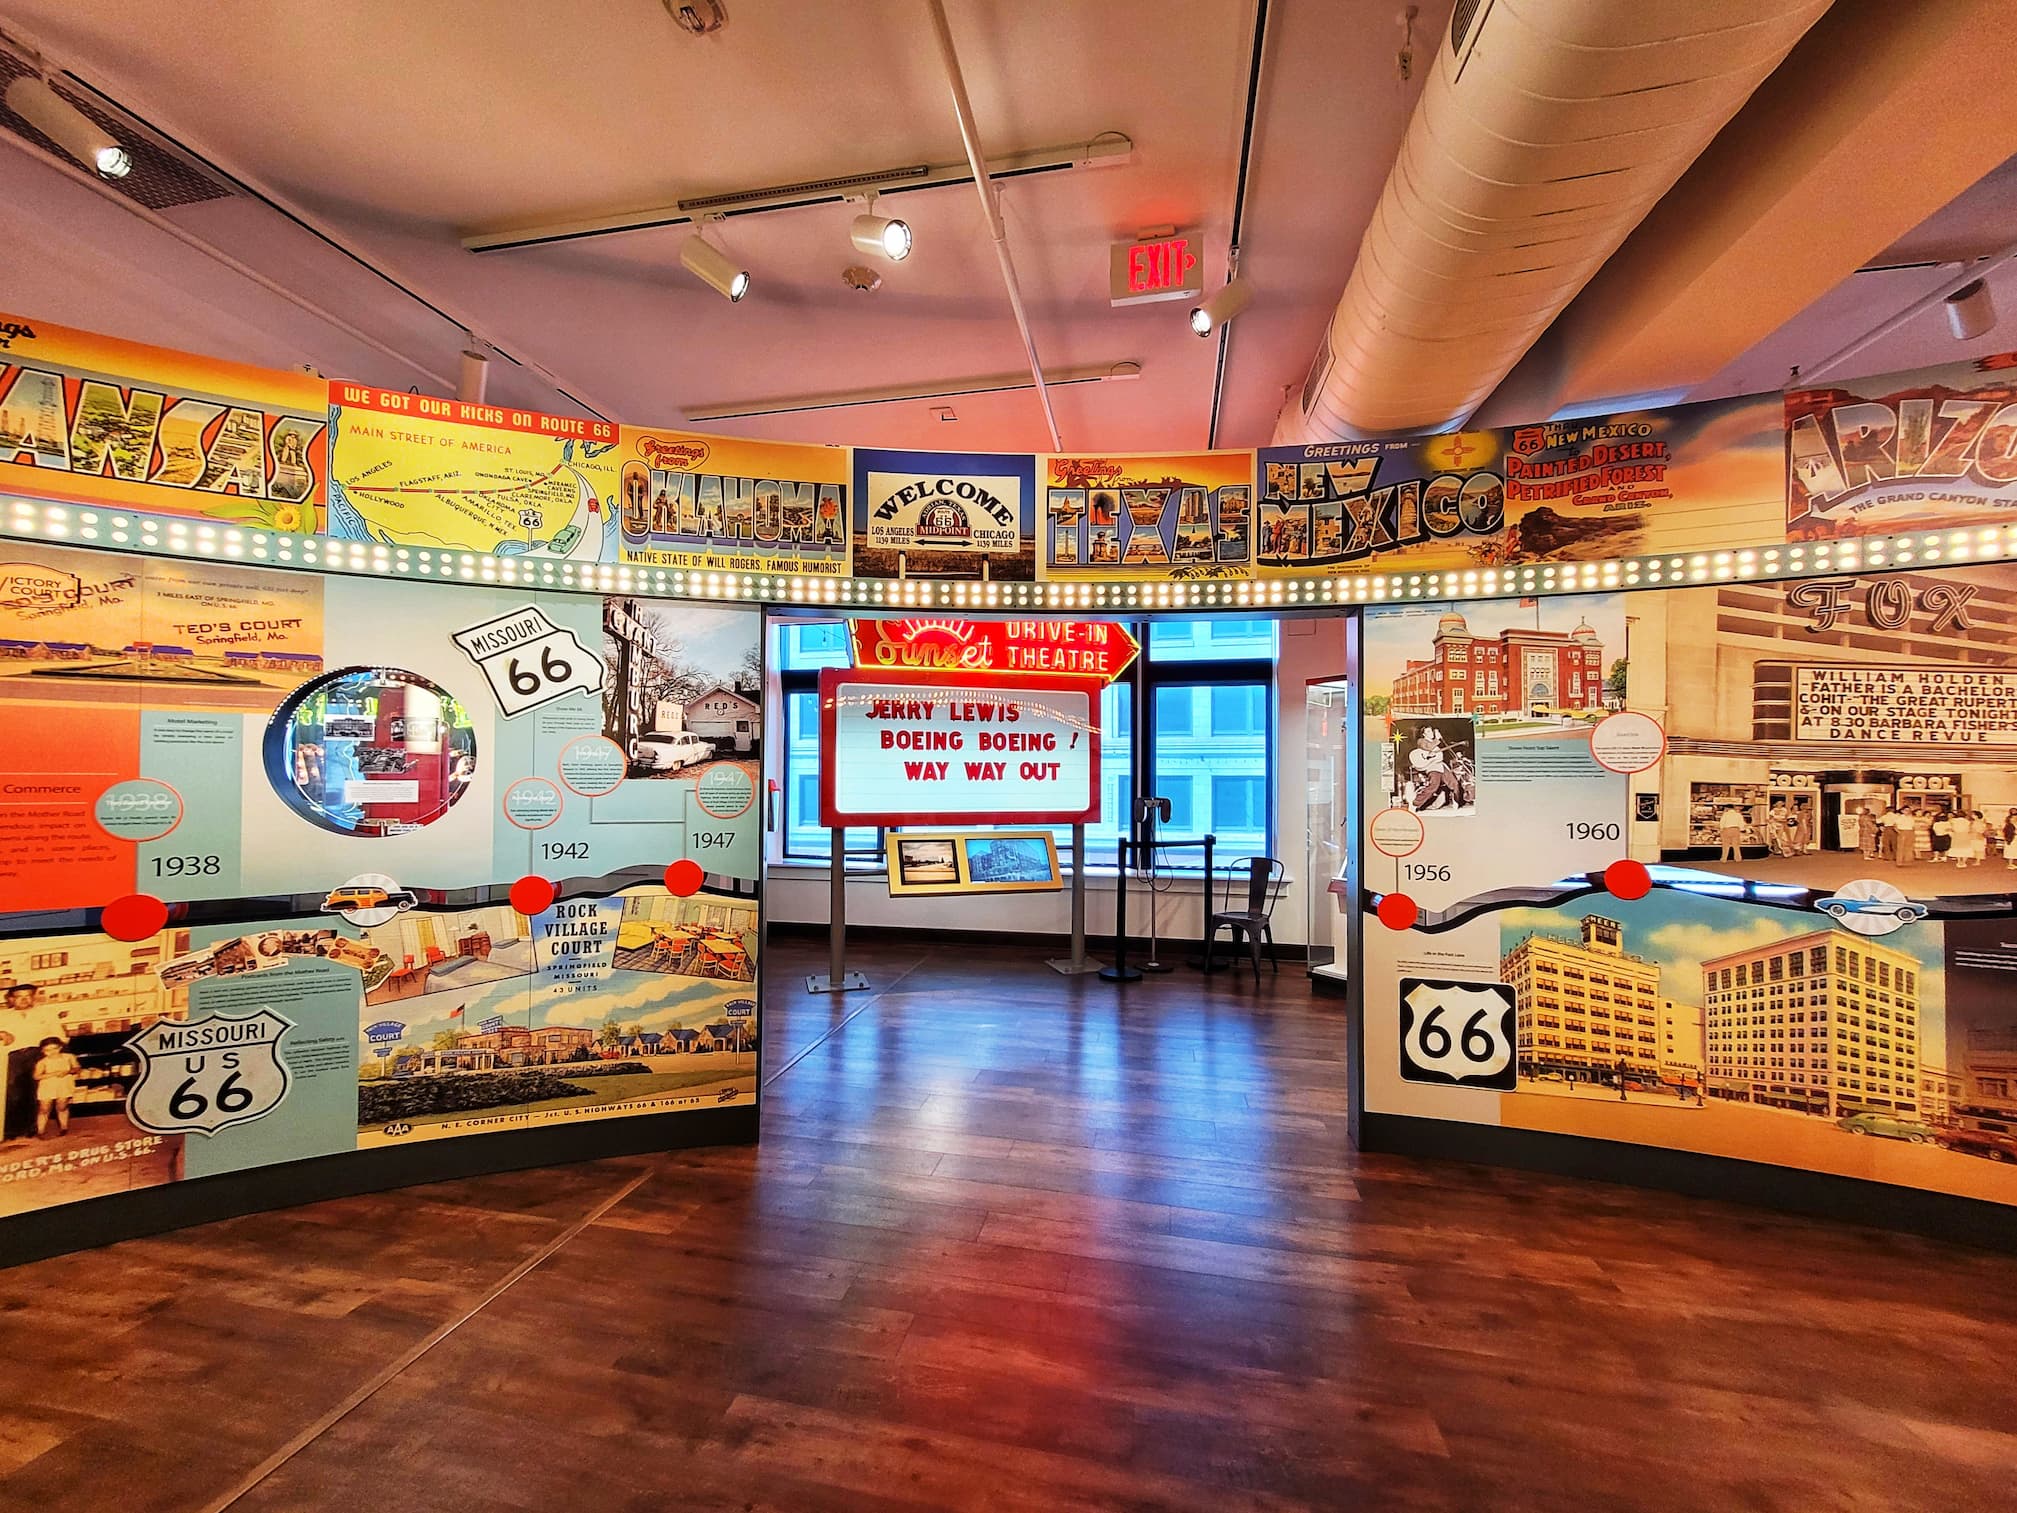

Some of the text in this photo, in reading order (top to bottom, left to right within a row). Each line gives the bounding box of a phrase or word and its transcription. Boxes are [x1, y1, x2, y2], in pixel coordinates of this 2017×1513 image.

[1128, 240, 1188, 292] EXIT
[344, 386, 611, 437] WE GOT OUR KICKS ON ROUTE 66
[0, 362, 327, 504] ANSAS
[350, 425, 512, 455] MAIN STREET OF AMERICA
[1547, 423, 1652, 448] NEW MEXICO
[644, 439, 705, 459] Greetings
[1303, 443, 1380, 458] GREETINGS
[1519, 440, 1538, 451] 66
[568, 462, 602, 471] CHICAGO,
[655, 454, 689, 468] from
[1506, 442, 1671, 479] PAINTED DESERT,
[346, 460, 392, 485] LOS ANGELES
[400, 474, 443, 487] FLAGSTAFF,
[1055, 459, 1123, 483] Greetings
[1264, 457, 1382, 501] NEW
[1506, 464, 1668, 501] PETRIFIED FOREST
[333, 494, 354, 524] PACIFIC
[359, 492, 405, 509] HOLLYWOOD
[435, 494, 488, 526] ALBUQUERQUE,
[462, 495, 502, 520] AMARILLO
[487, 502, 504, 513] CITY
[621, 460, 845, 545] OKLAHOMA
[873, 479, 1013, 527] WELCOME
[1849, 493, 1988, 514] THE GRAND CANYON
[949, 502, 966, 520] TEXAS
[1257, 473, 1504, 560] MEXICO
[523, 518, 540, 527] 66
[872, 526, 914, 536] LOS ANGELES
[920, 526, 967, 535] MIDPOINT
[936, 518, 952, 526] 66
[1048, 485, 1251, 564] TEXAS
[890, 537, 910, 545] MILES
[974, 530, 1015, 540] CHICAGO
[627, 551, 841, 574] NATIVE STATE OF WILL ROGERS, FAMOUS HUMORIST
[1787, 579, 1979, 632] FOX
[173, 619, 302, 635] TED'S COURT
[470, 617, 542, 655] MISSOURI
[1007, 622, 1108, 644] DRIVE-IN
[196, 633, 261, 645] Springfield,
[875, 620, 992, 667] Sunset
[1007, 647, 1108, 671] THEATRE
[509, 646, 572, 695] 66
[1813, 671, 2004, 685] WILLIAM HOLDEN
[1882, 685, 2015, 696] IS A BACHELOR
[705, 700, 738, 710] RED'S
[865, 700, 1019, 722] JERRY LEWIS
[1897, 696, 1948, 706] GREAT
[1953, 697, 2017, 708] RUPERT
[1802, 716, 1824, 727] AT
[1870, 718, 1946, 729] BARBARA
[1820, 706, 2017, 720] ON OUR STAGE TONIGHT
[881, 730, 1078, 752] BOEING BOEING !
[1830, 729, 1987, 741] DANCE REVUE
[706, 771, 745, 785] 1947
[904, 761, 1060, 781] WAY WAY OUT
[3, 784, 81, 793] Commerce
[1899, 776, 1956, 789] COOL
[106, 793, 168, 811] 1938
[692, 832, 735, 849] 1947
[1566, 822, 1620, 841] 1960
[541, 842, 589, 860] 1942
[151, 855, 220, 877] 1938
[1404, 863, 1451, 882] 1956
[556, 904, 598, 918] ROCK
[544, 922, 607, 937] VILLAGE
[552, 940, 602, 955] COURT
[547, 962, 607, 970] SPRINGFIELD
[159, 1021, 265, 1050] MISSOURI
[370, 1032, 400, 1042] COURT
[1419, 1005, 1495, 1063] 66
[185, 1051, 239, 1073] U S
[169, 1071, 254, 1120] 66
[466, 1118, 505, 1127] CORNER
[509, 1114, 530, 1122] CITY
[585, 1104, 633, 1114] HIGHWAYS
[387, 1123, 409, 1136] AAA
[68, 1135, 163, 1160] DRUG STORE
[81, 1157, 100, 1167] ON
